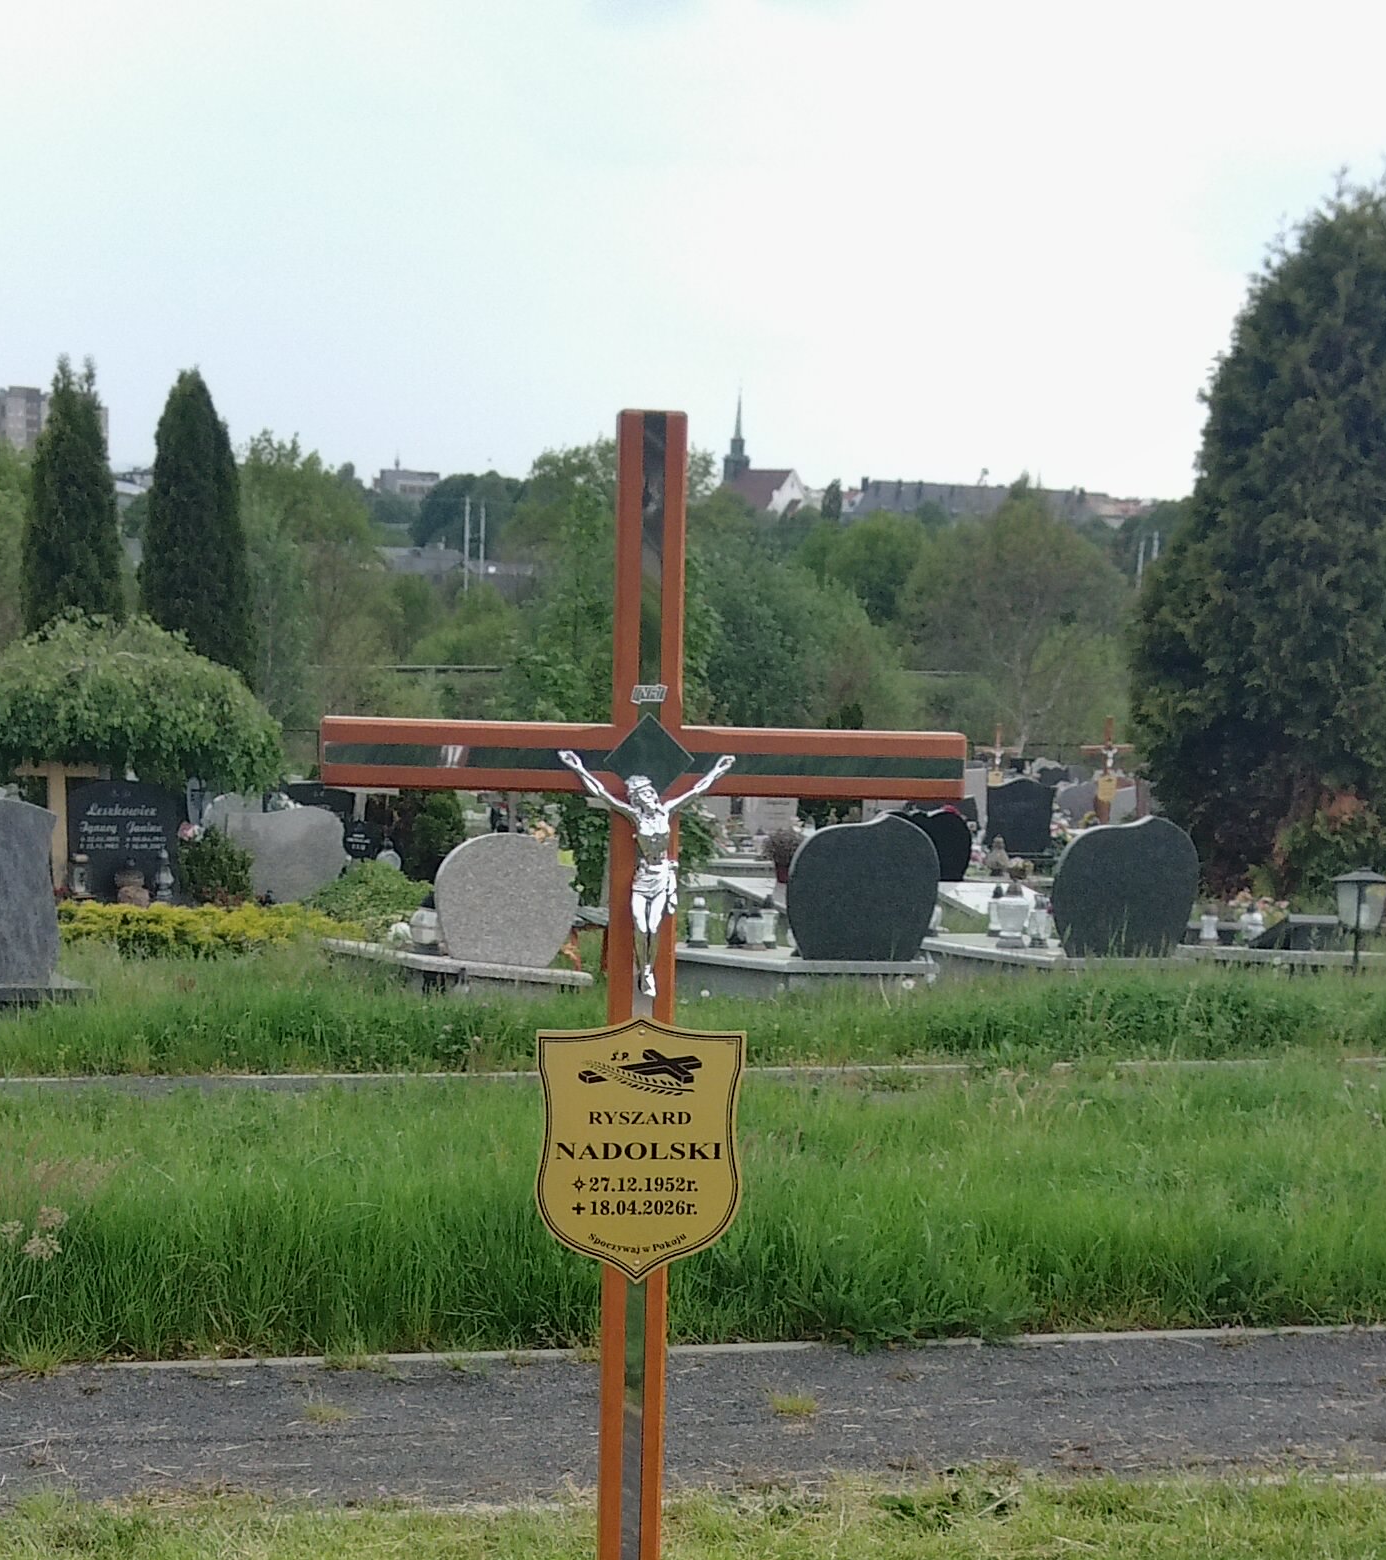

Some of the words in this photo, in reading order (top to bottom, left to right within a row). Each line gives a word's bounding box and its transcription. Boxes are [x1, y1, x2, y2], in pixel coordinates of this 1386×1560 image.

[588, 1111, 692, 1125] RYSZARD
[555, 1142, 722, 1161] NADOLSKI
[589, 1177, 699, 1193] 27.12.1952r.
[590, 1200, 698, 1216] 18.04.2026r.
[588, 1233, 640, 1254] Spoczywaj
[652, 1233, 687, 1252] Pokoju
